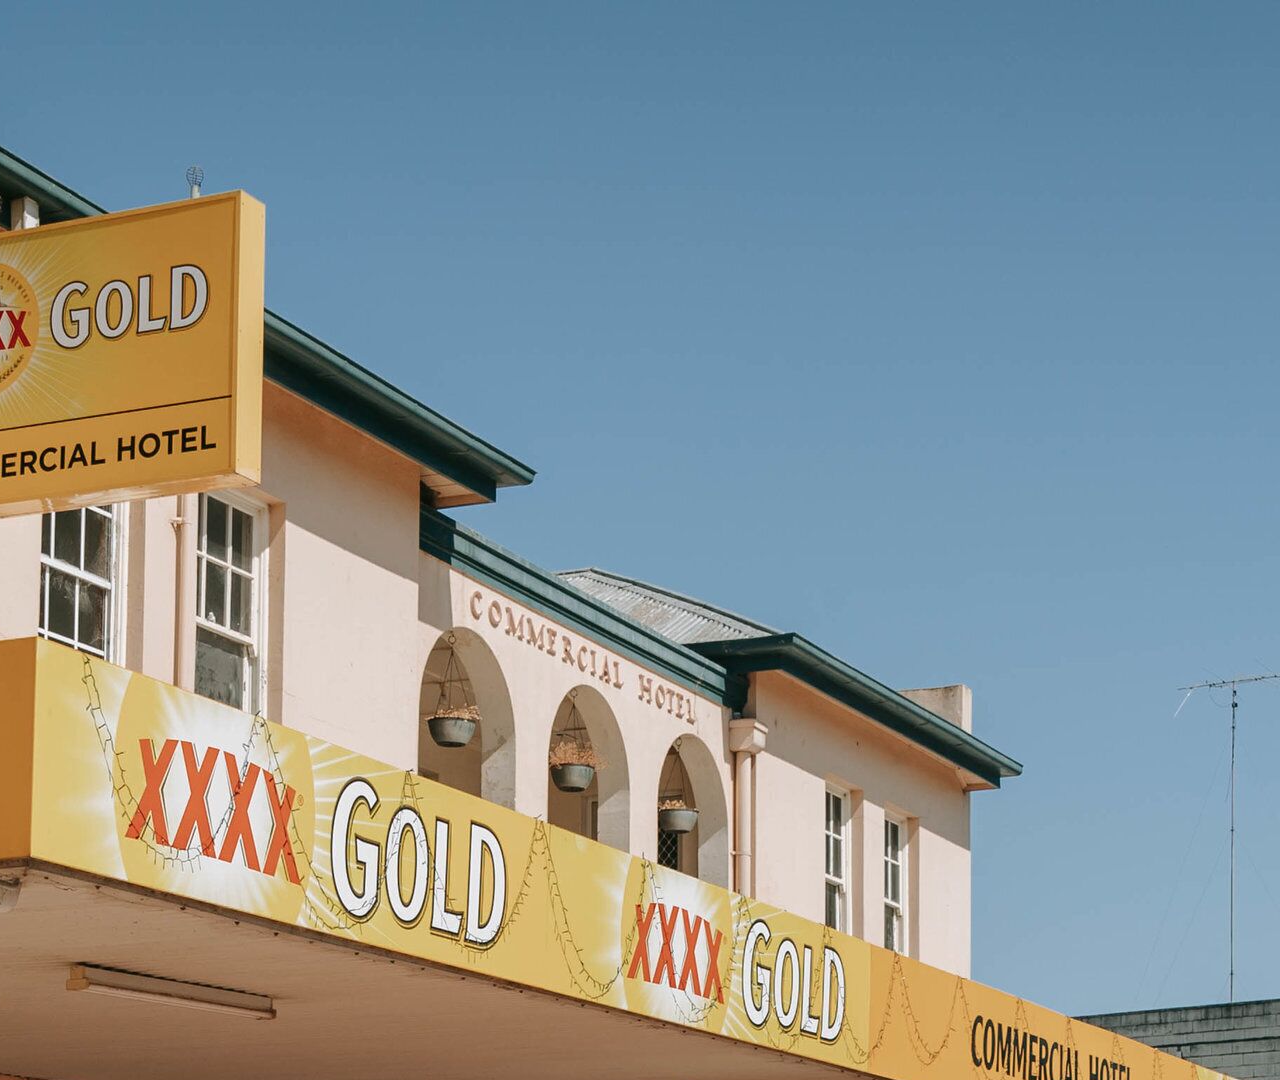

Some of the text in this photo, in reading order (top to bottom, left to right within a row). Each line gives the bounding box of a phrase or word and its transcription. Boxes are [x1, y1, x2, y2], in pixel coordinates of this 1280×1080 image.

[50, 264, 209, 349] GOLD
[117, 425, 216, 462] HOTEL
[470, 590, 697, 725] COMMERCIAL HOTEL
[125, 738, 508, 951] XXXX GOLD
[626, 902, 846, 1045] XXXX GOLD
